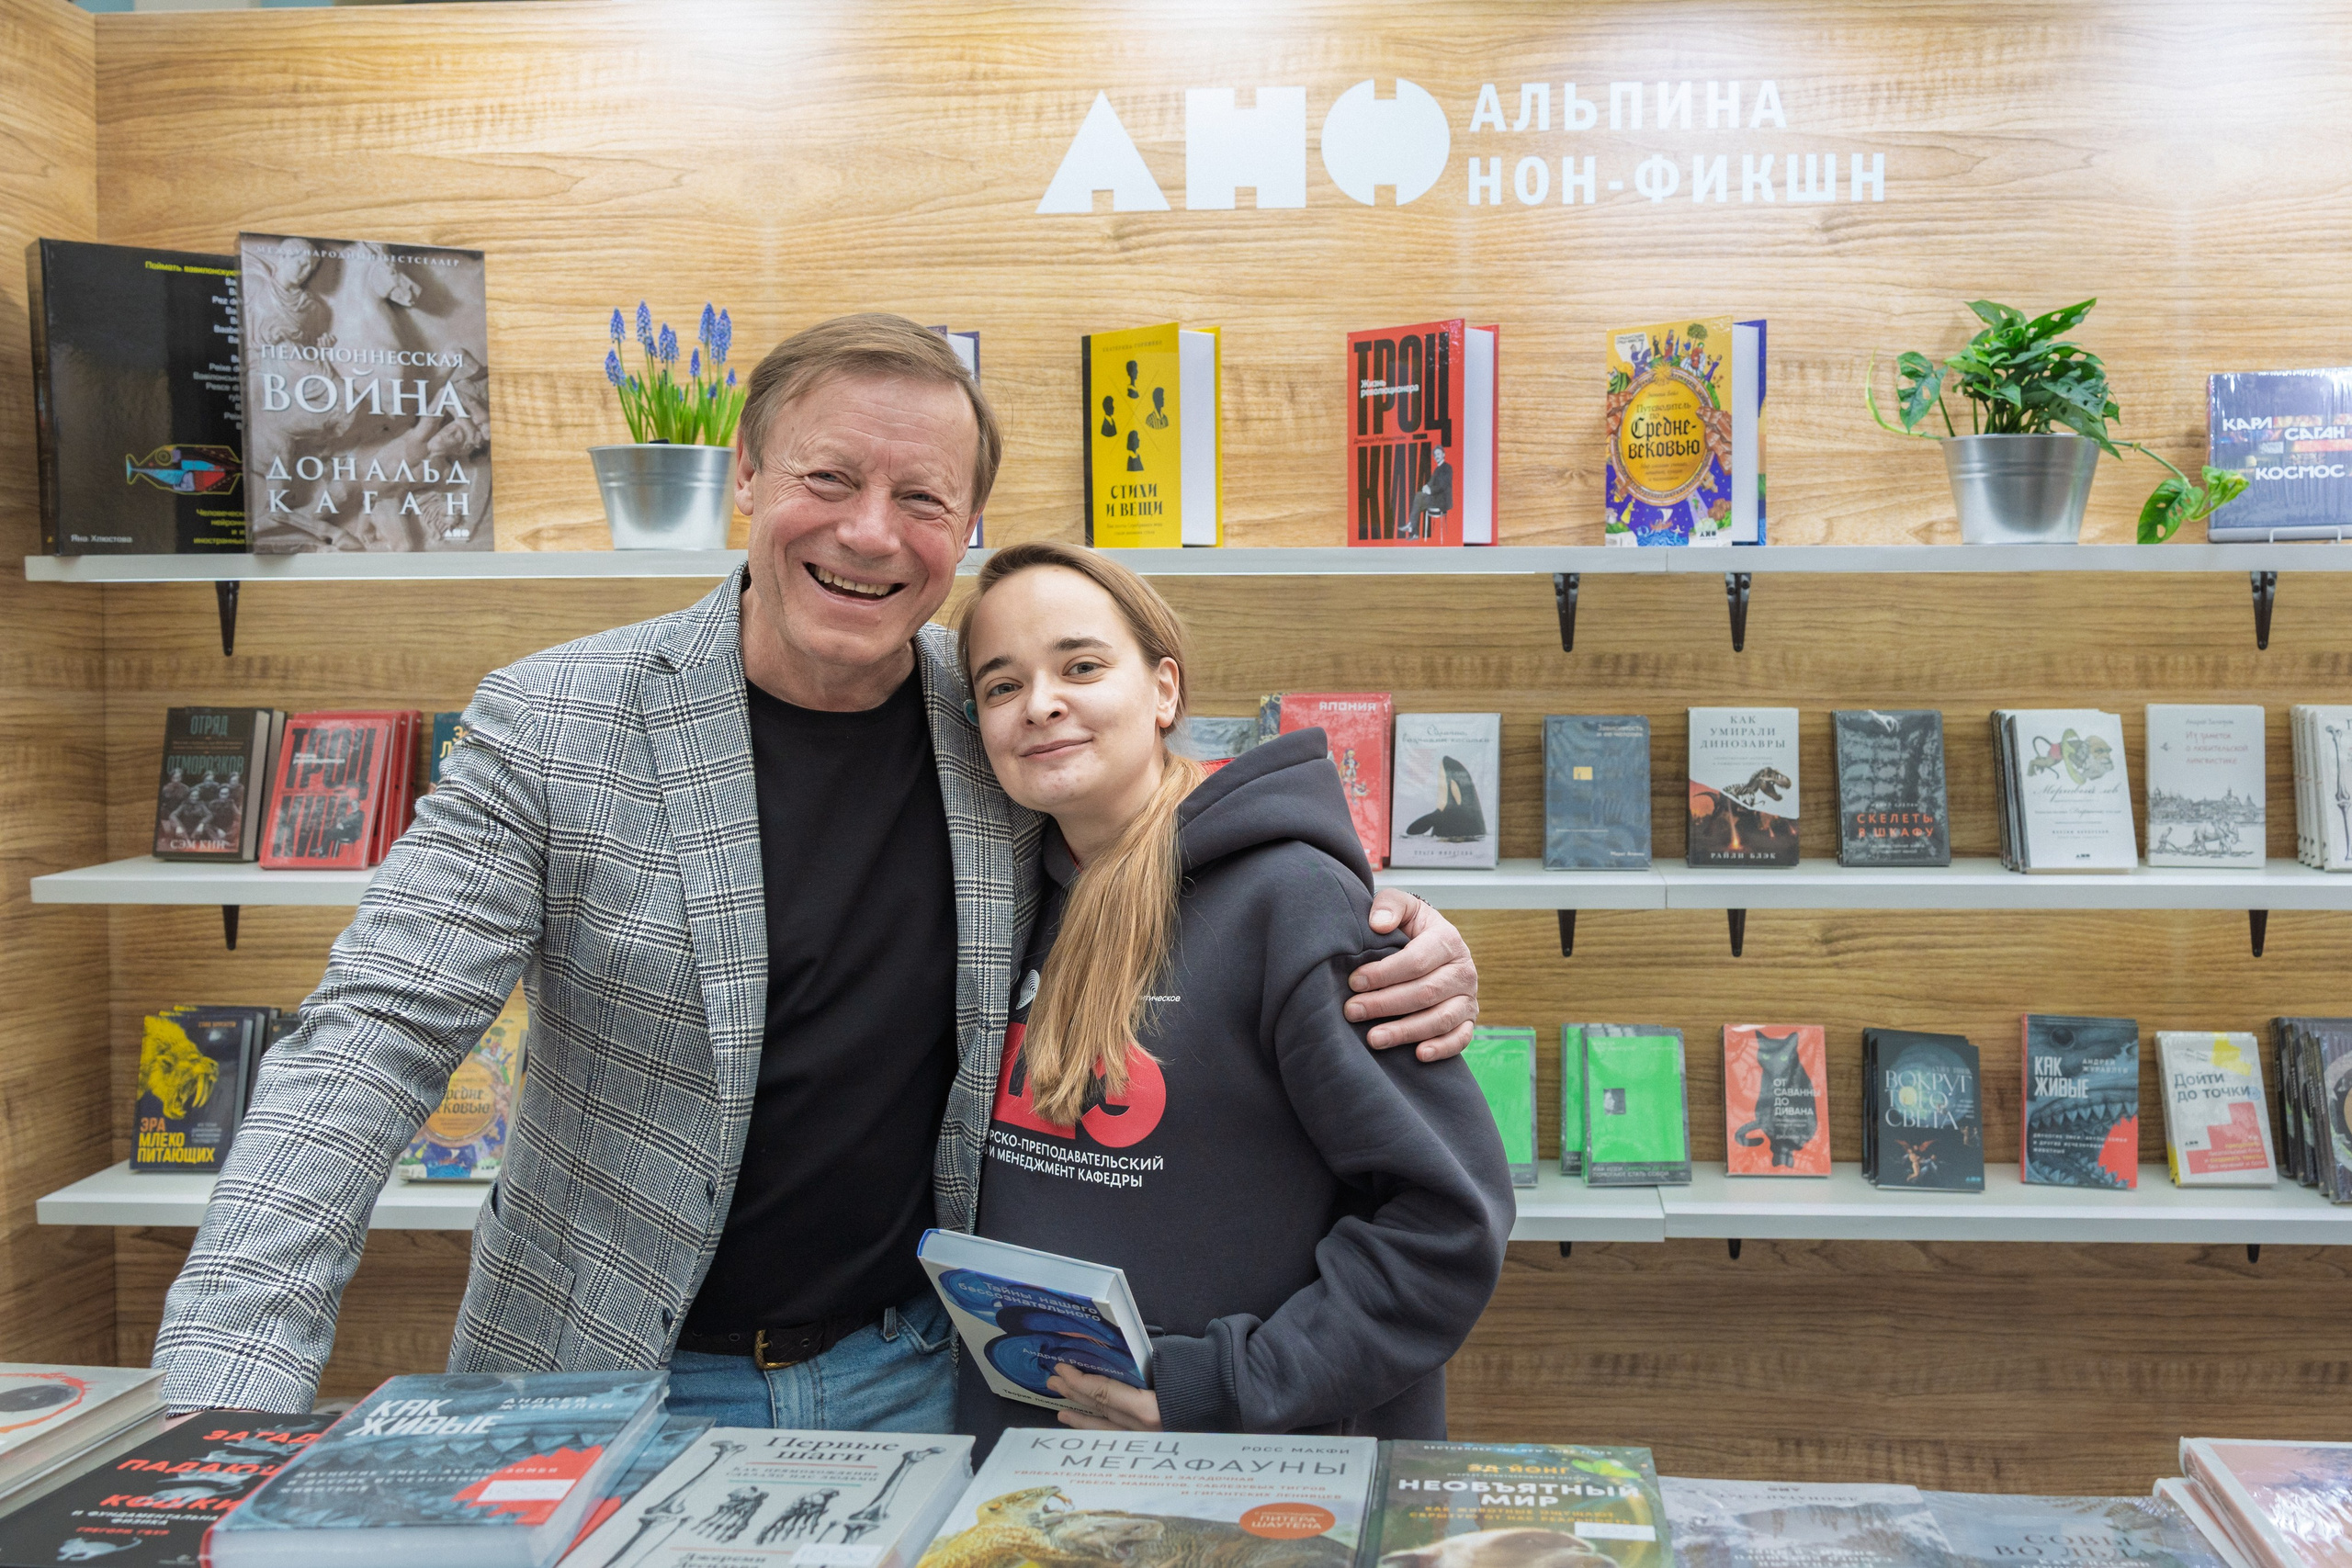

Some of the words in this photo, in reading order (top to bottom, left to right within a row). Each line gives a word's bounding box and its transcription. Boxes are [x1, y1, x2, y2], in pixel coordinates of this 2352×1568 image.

[1470, 80, 1788, 133] АЛЬПИНА
[1469, 152, 1886, 207] НОН-ФИКШН
[256, 245, 376, 261] МЕЖДУНАРОДНЫЙ
[381, 254, 460, 267] БЕСТСЕЛЛЕР
[261, 344, 463, 367] ПЕЛОПОННЕССКАЯ
[1354, 332, 1452, 446] ТРОЦ
[1361, 379, 1386, 389] Жизнь
[1361, 384, 1419, 399] революционера
[262, 368, 470, 418] ВОЙНА
[1637, 402, 1691, 415] Путеводитель
[1631, 417, 1696, 441] Средне-
[2222, 416, 2272, 431] КАРЛ
[2284, 426, 2345, 441] САГАН
[1628, 439, 1700, 459] вековью
[266, 456, 470, 485] ДОНАЛЬД
[2256, 464, 2345, 480] КОСМОС
[1111, 483, 1157, 499] СТИХИ
[267, 489, 469, 516] КАГАН
[1106, 503, 1114, 516] И
[1120, 501, 1163, 518] ВЕЩИ
[71, 535, 89, 543] Яна
[91, 535, 132, 543] Хлюстова
[1319, 701, 1377, 712] ЯПОНИЯ
[190, 715, 228, 737] ОТРЯД
[1730, 716, 1757, 724] КАК
[1710, 728, 1776, 736] УМИРАЛИ
[1700, 739, 1786, 749] ДИНОЗАВРЫ
[166, 755, 244, 775] ОТМОРОЗКОВ
[285, 728, 377, 801] ТРОЦ
[1857, 813, 1933, 824] СКЕЛЕТЫ
[1859, 828, 1866, 838] В
[1873, 828, 1934, 838] ШКАФУ
[170, 840, 197, 850] СЭМ
[2034, 1056, 2062, 1077] КАК
[1773, 1078, 1787, 1087] ОТ
[1885, 1070, 1973, 1096] ВОКРУГ
[2034, 1077, 2089, 1099] ЖИВЫЕ
[2174, 1071, 2224, 1089] Дойти
[446, 1088, 489, 1101] редне-
[1773, 1088, 1821, 1097] САВАННЫ
[1884, 1087, 1948, 1109] ТОГО
[2177, 1090, 2198, 1102] до
[2202, 1086, 2251, 1099] точки
[1774, 1097, 1790, 1106] ДО
[1774, 1107, 1814, 1116] ДИВАНА
[1885, 1108, 1959, 1130] СВЕТА
[141, 1118, 165, 1133] ЭРА
[139, 1133, 186, 1147] МЛЕКО
[137, 1147, 215, 1164] ПИТАЮЩИХ
[997, 1147, 1075, 1179] МЕНЕДЖМЕНТ
[1078, 1168, 1143, 1188] КАФЕДРЫ
[982, 1281, 1032, 1300] Тайны
[1039, 1296, 1098, 1315] нашего
[1022, 1348, 1065, 1363] Андрей
[1069, 1359, 1124, 1376] Россохин
[368, 1397, 453, 1417] КАК
[1002, 1388, 1032, 1400] Теория
[1035, 1397, 1093, 1415] психоанализа
[346, 1416, 503, 1436] ЖИВЫЕ
[202, 1429, 321, 1444] ЗАГАД
[763, 1437, 899, 1451] Первые
[1030, 1437, 1180, 1456] КОНЕЦ
[775, 1450, 867, 1462] шаги
[1060, 1454, 1347, 1475] МЕГАФАУНЫ
[1014, 1470, 1113, 1478] УВЛЕКАТЕЛЬНАЯ
[1398, 1479, 1639, 1497] НЕОБЪЯТНЫЙ
[99, 1494, 242, 1512] КОШКИ
[1481, 1494, 1558, 1506] МИР
[87, 1511, 220, 1521] ФУНДАМЕНТАЛЬНА
[111, 1517, 169, 1526] ФИЗИКА
[1251, 1521, 1322, 1529] ШАУТЕНА
[2024, 1534, 2132, 1547] СОВЫ
[1994, 1545, 2044, 1556] ВО
